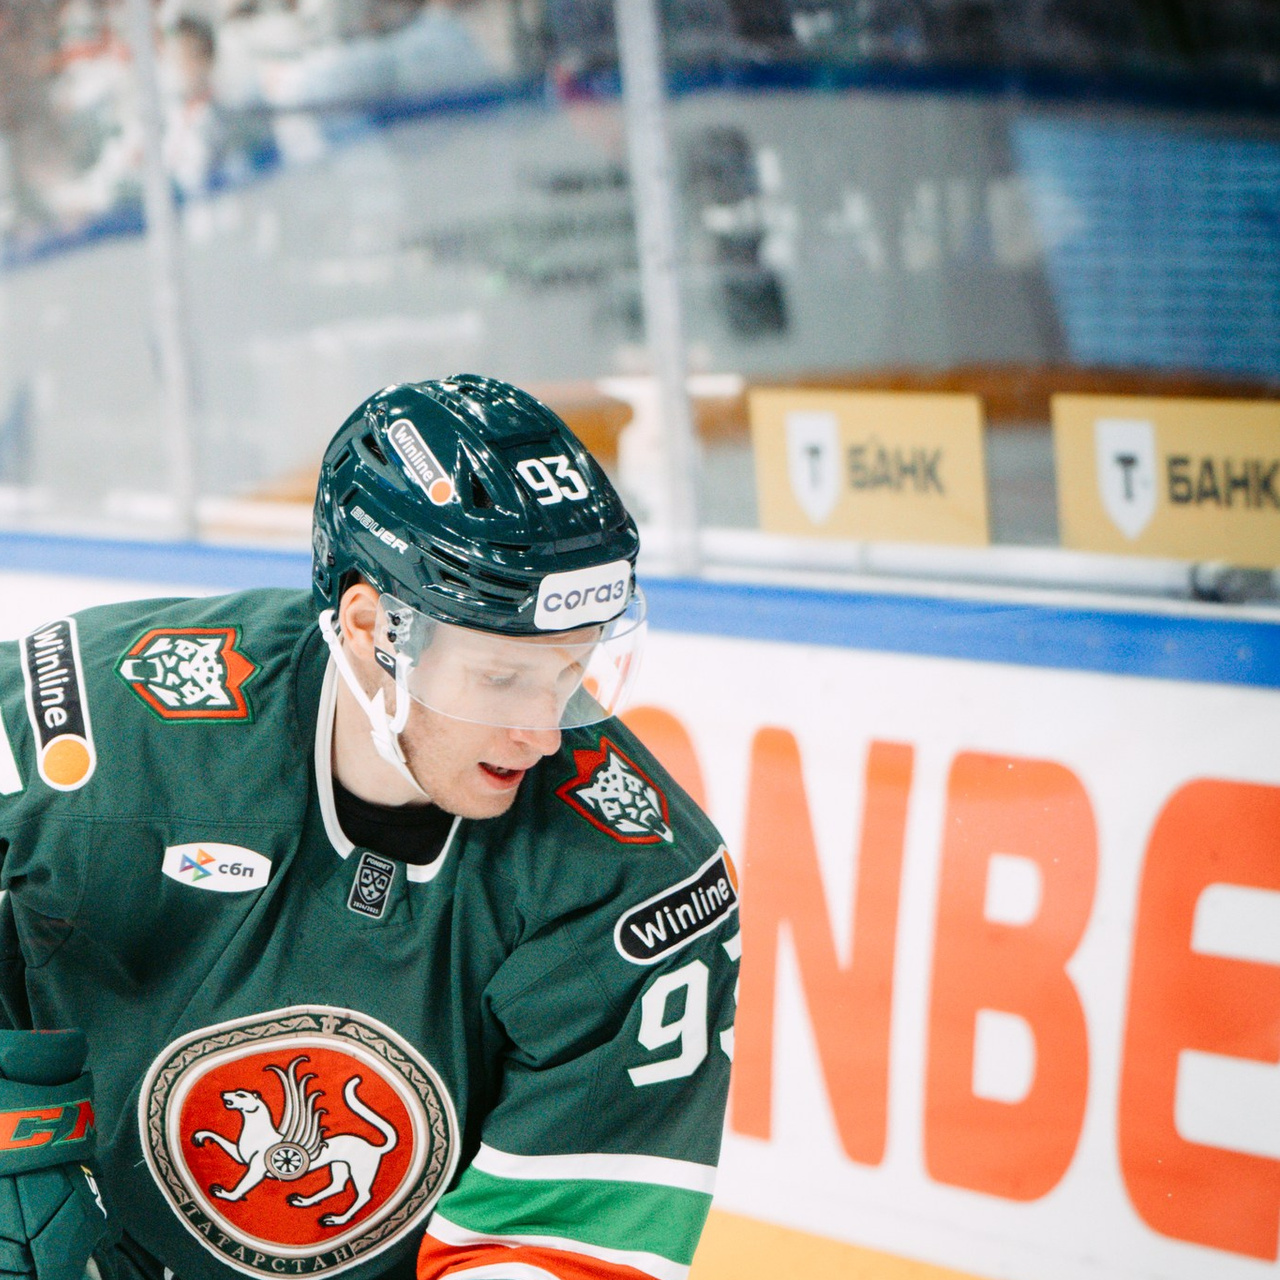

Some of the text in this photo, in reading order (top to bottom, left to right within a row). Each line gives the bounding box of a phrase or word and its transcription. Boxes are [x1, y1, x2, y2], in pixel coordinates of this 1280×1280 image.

[394, 425, 435, 483] Winline
[515, 455, 590, 506] 93
[847, 442, 946, 497] БАНК
[1166, 453, 1280, 509] БАНК
[543, 579, 625, 613] согаз
[33, 624, 69, 729] Winline
[217, 862, 255, 878] сбп
[630, 877, 730, 950] Winline
[184, 1200, 351, 1274] ТАТАРСТАН
